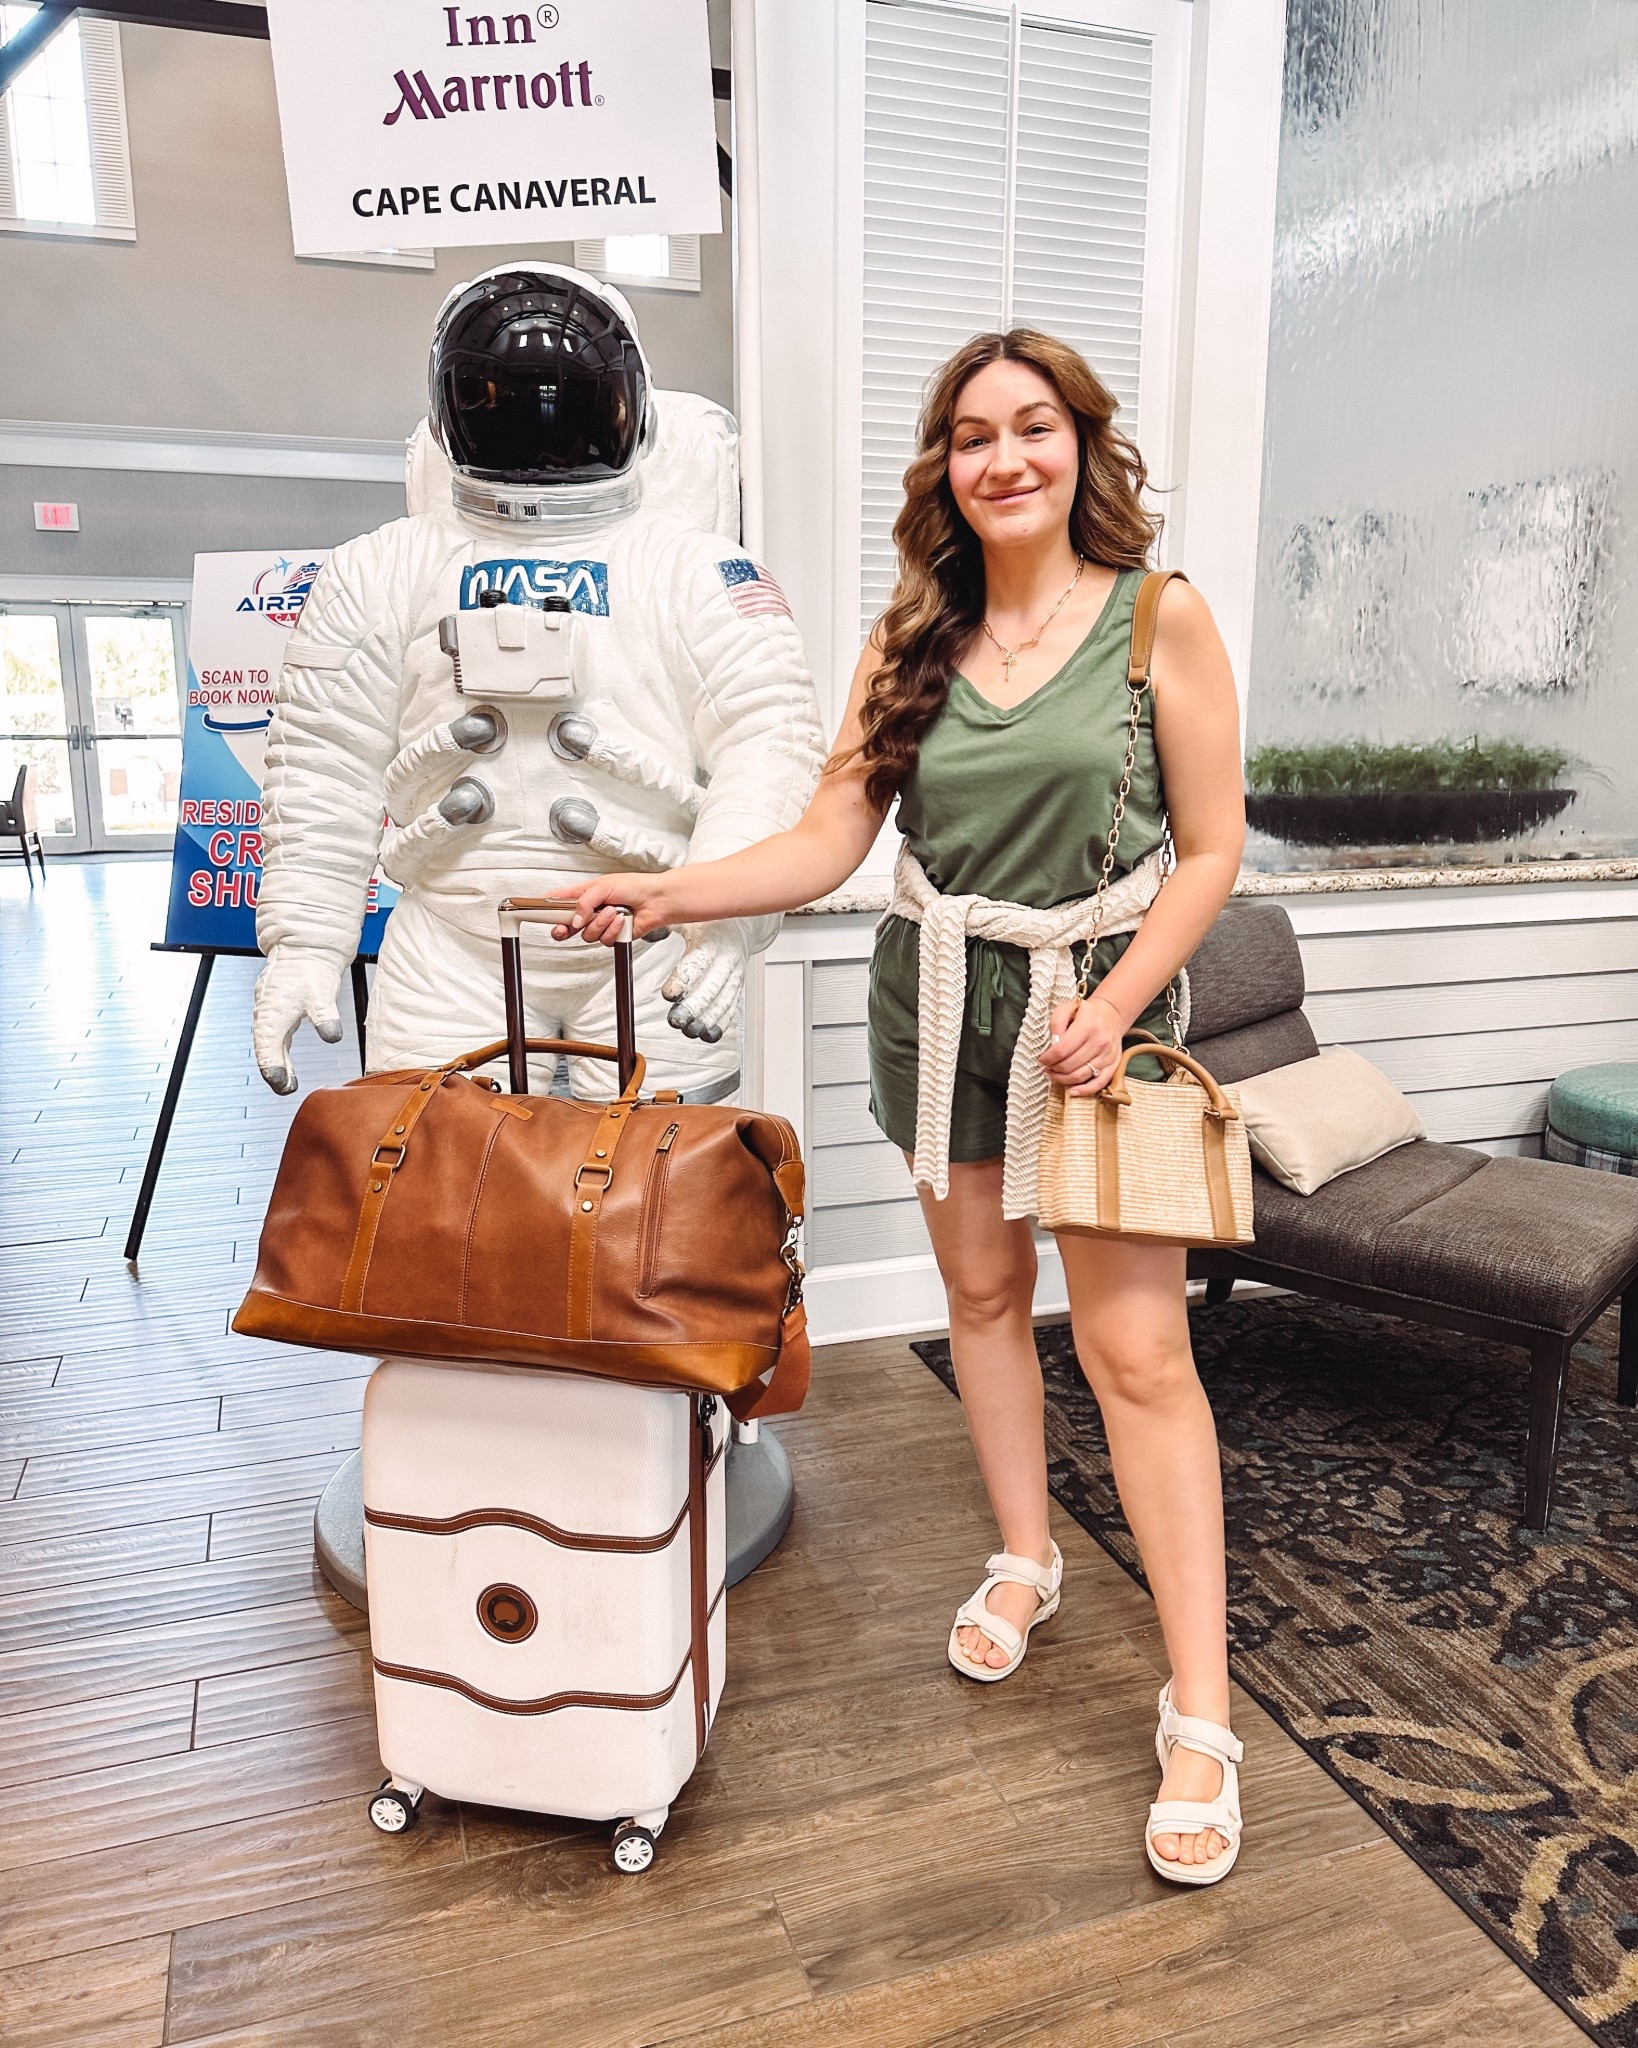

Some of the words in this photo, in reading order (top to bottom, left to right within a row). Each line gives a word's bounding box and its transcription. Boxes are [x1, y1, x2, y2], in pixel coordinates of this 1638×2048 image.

[351, 185, 442, 218] CAPE
[449, 175, 657, 212] CANAVERAL
[467, 564, 601, 608] NASA
[235, 595, 306, 612] AIRP
[201, 670, 243, 685] SCAN
[248, 669, 269, 684] TO
[189, 689, 233, 705] BOOK
[237, 688, 275, 704] NOW
[181, 800, 262, 826] RESID
[208, 830, 264, 867] CR
[188, 870, 258, 908] SHU
